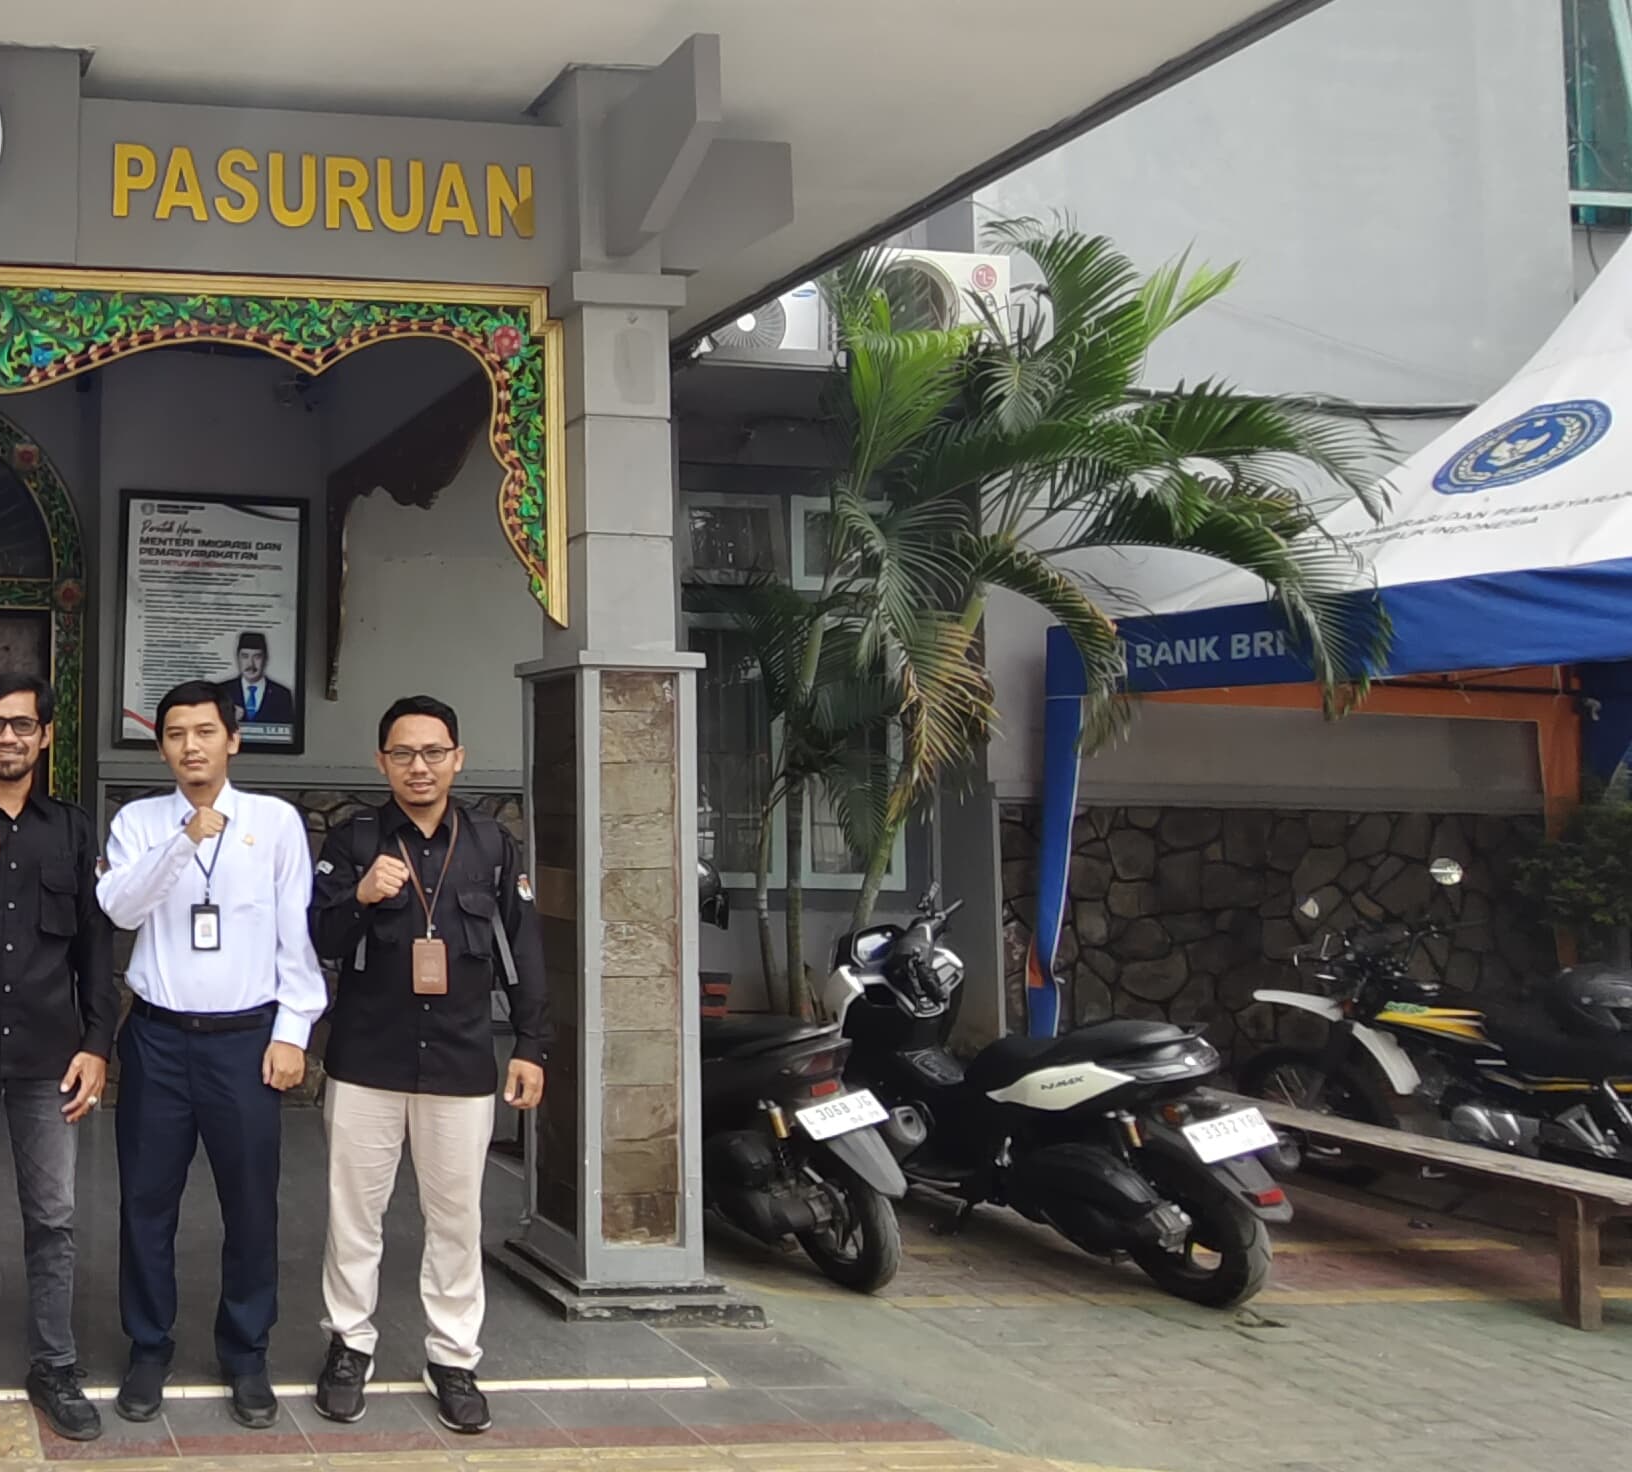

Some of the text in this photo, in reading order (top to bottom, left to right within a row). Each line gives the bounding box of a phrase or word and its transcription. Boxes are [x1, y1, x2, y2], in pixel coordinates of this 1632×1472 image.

[112, 142, 536, 239] PASURUAN
[139, 536, 282, 552] MENTERI IMIGRASI DAN
[139, 547, 259, 561] PEMASYARAKATAN
[1134, 630, 1286, 669] BANK BRI
